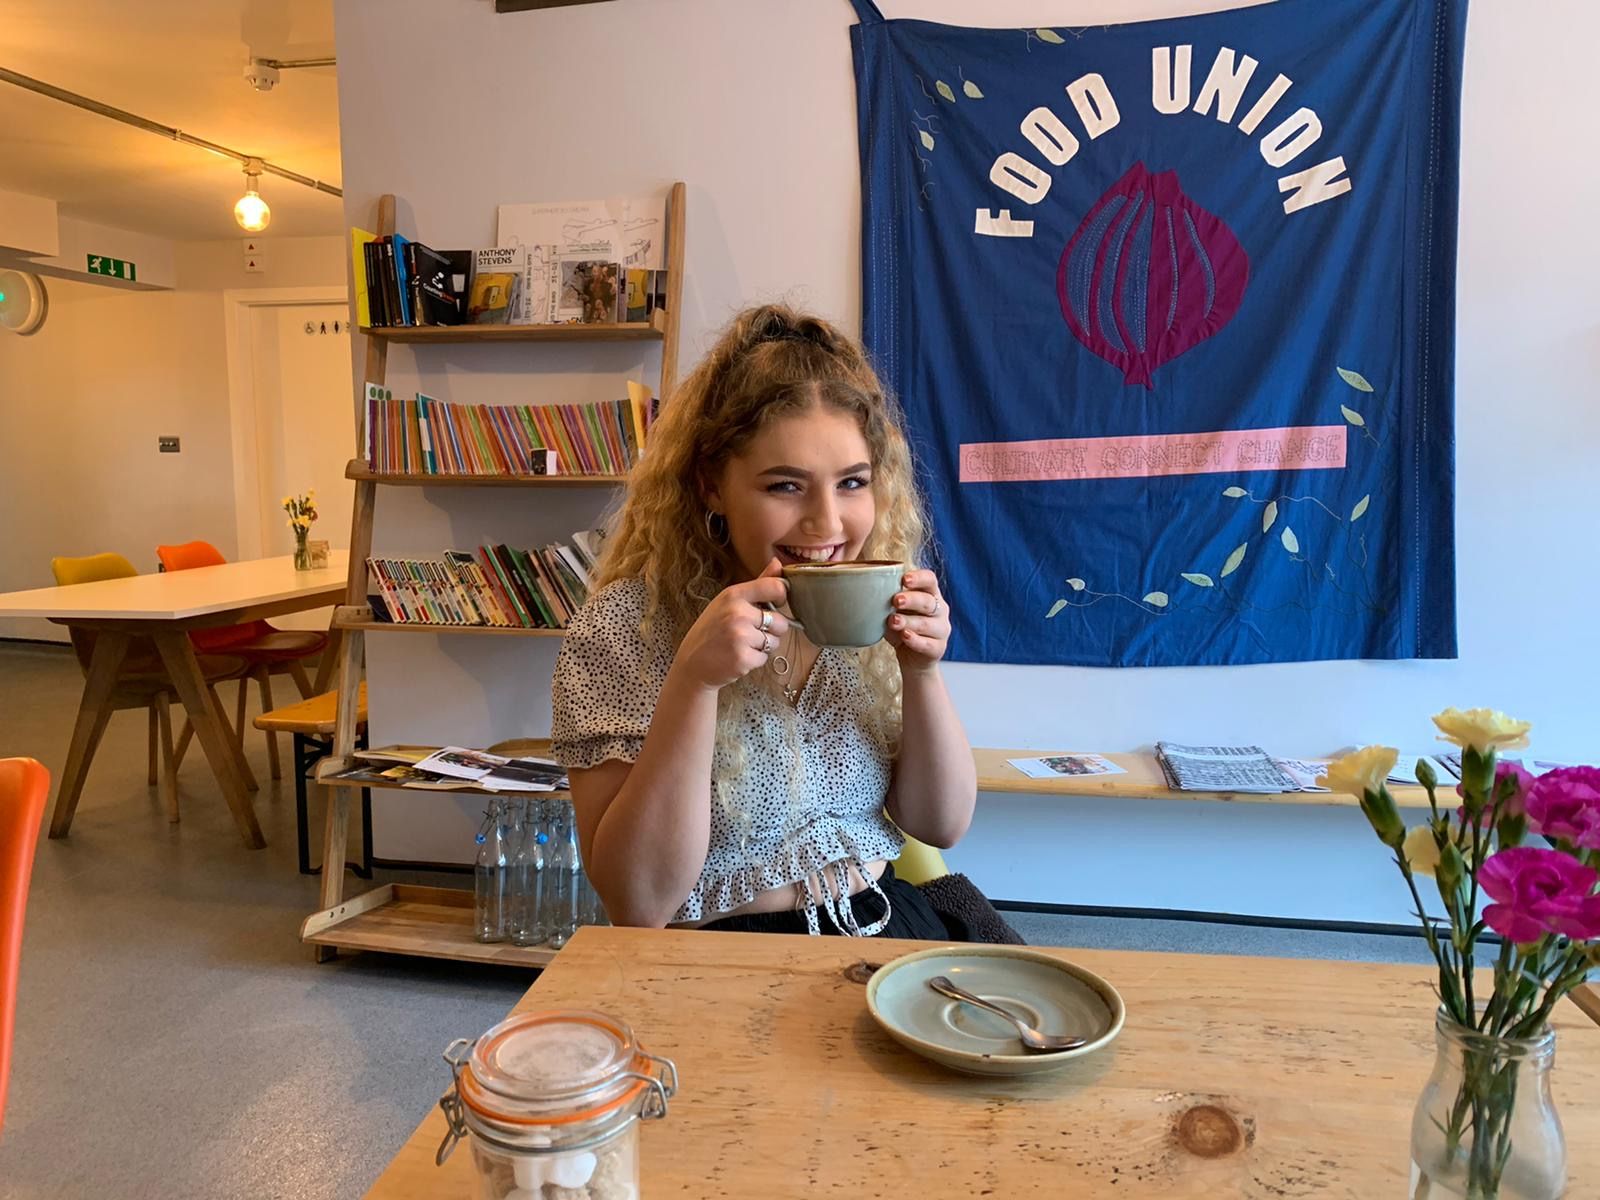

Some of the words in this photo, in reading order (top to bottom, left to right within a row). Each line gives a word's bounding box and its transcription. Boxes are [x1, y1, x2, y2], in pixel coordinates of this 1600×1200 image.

[974, 73, 1121, 238] FOOD
[1151, 45, 1352, 214] UNION
[478, 248, 517, 257] ANTHONY
[478, 256, 513, 266] STEVENS
[965, 446, 1088, 476] CULTIVATE
[1103, 439, 1225, 471] CONNECT
[1237, 433, 1342, 465] CHANGE
